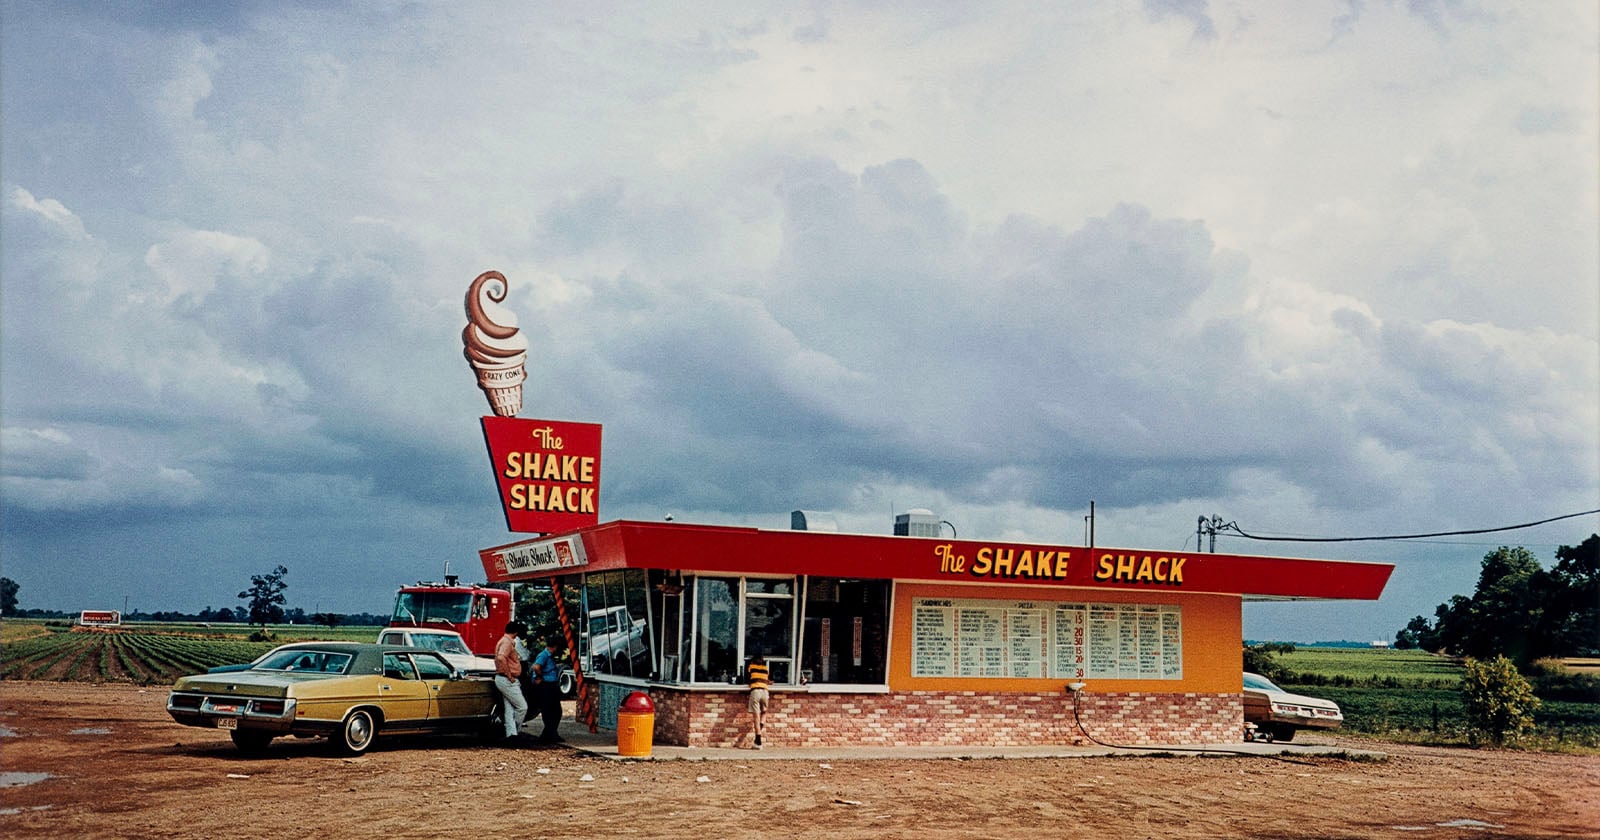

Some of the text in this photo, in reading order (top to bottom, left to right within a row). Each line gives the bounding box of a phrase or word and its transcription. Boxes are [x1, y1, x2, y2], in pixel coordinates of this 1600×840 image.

[484, 369, 520, 380] CRAZY CONE
[532, 426, 564, 450] The
[505, 451, 595, 483] SHAKE
[510, 483, 595, 514] SHACK
[508, 550, 530, 570] Shake
[530, 545, 555, 566] Shack
[934, 544, 1187, 584] The SHAKE SHACK
[1075, 614, 1083, 625] 15
[1074, 627, 1084, 637] 20
